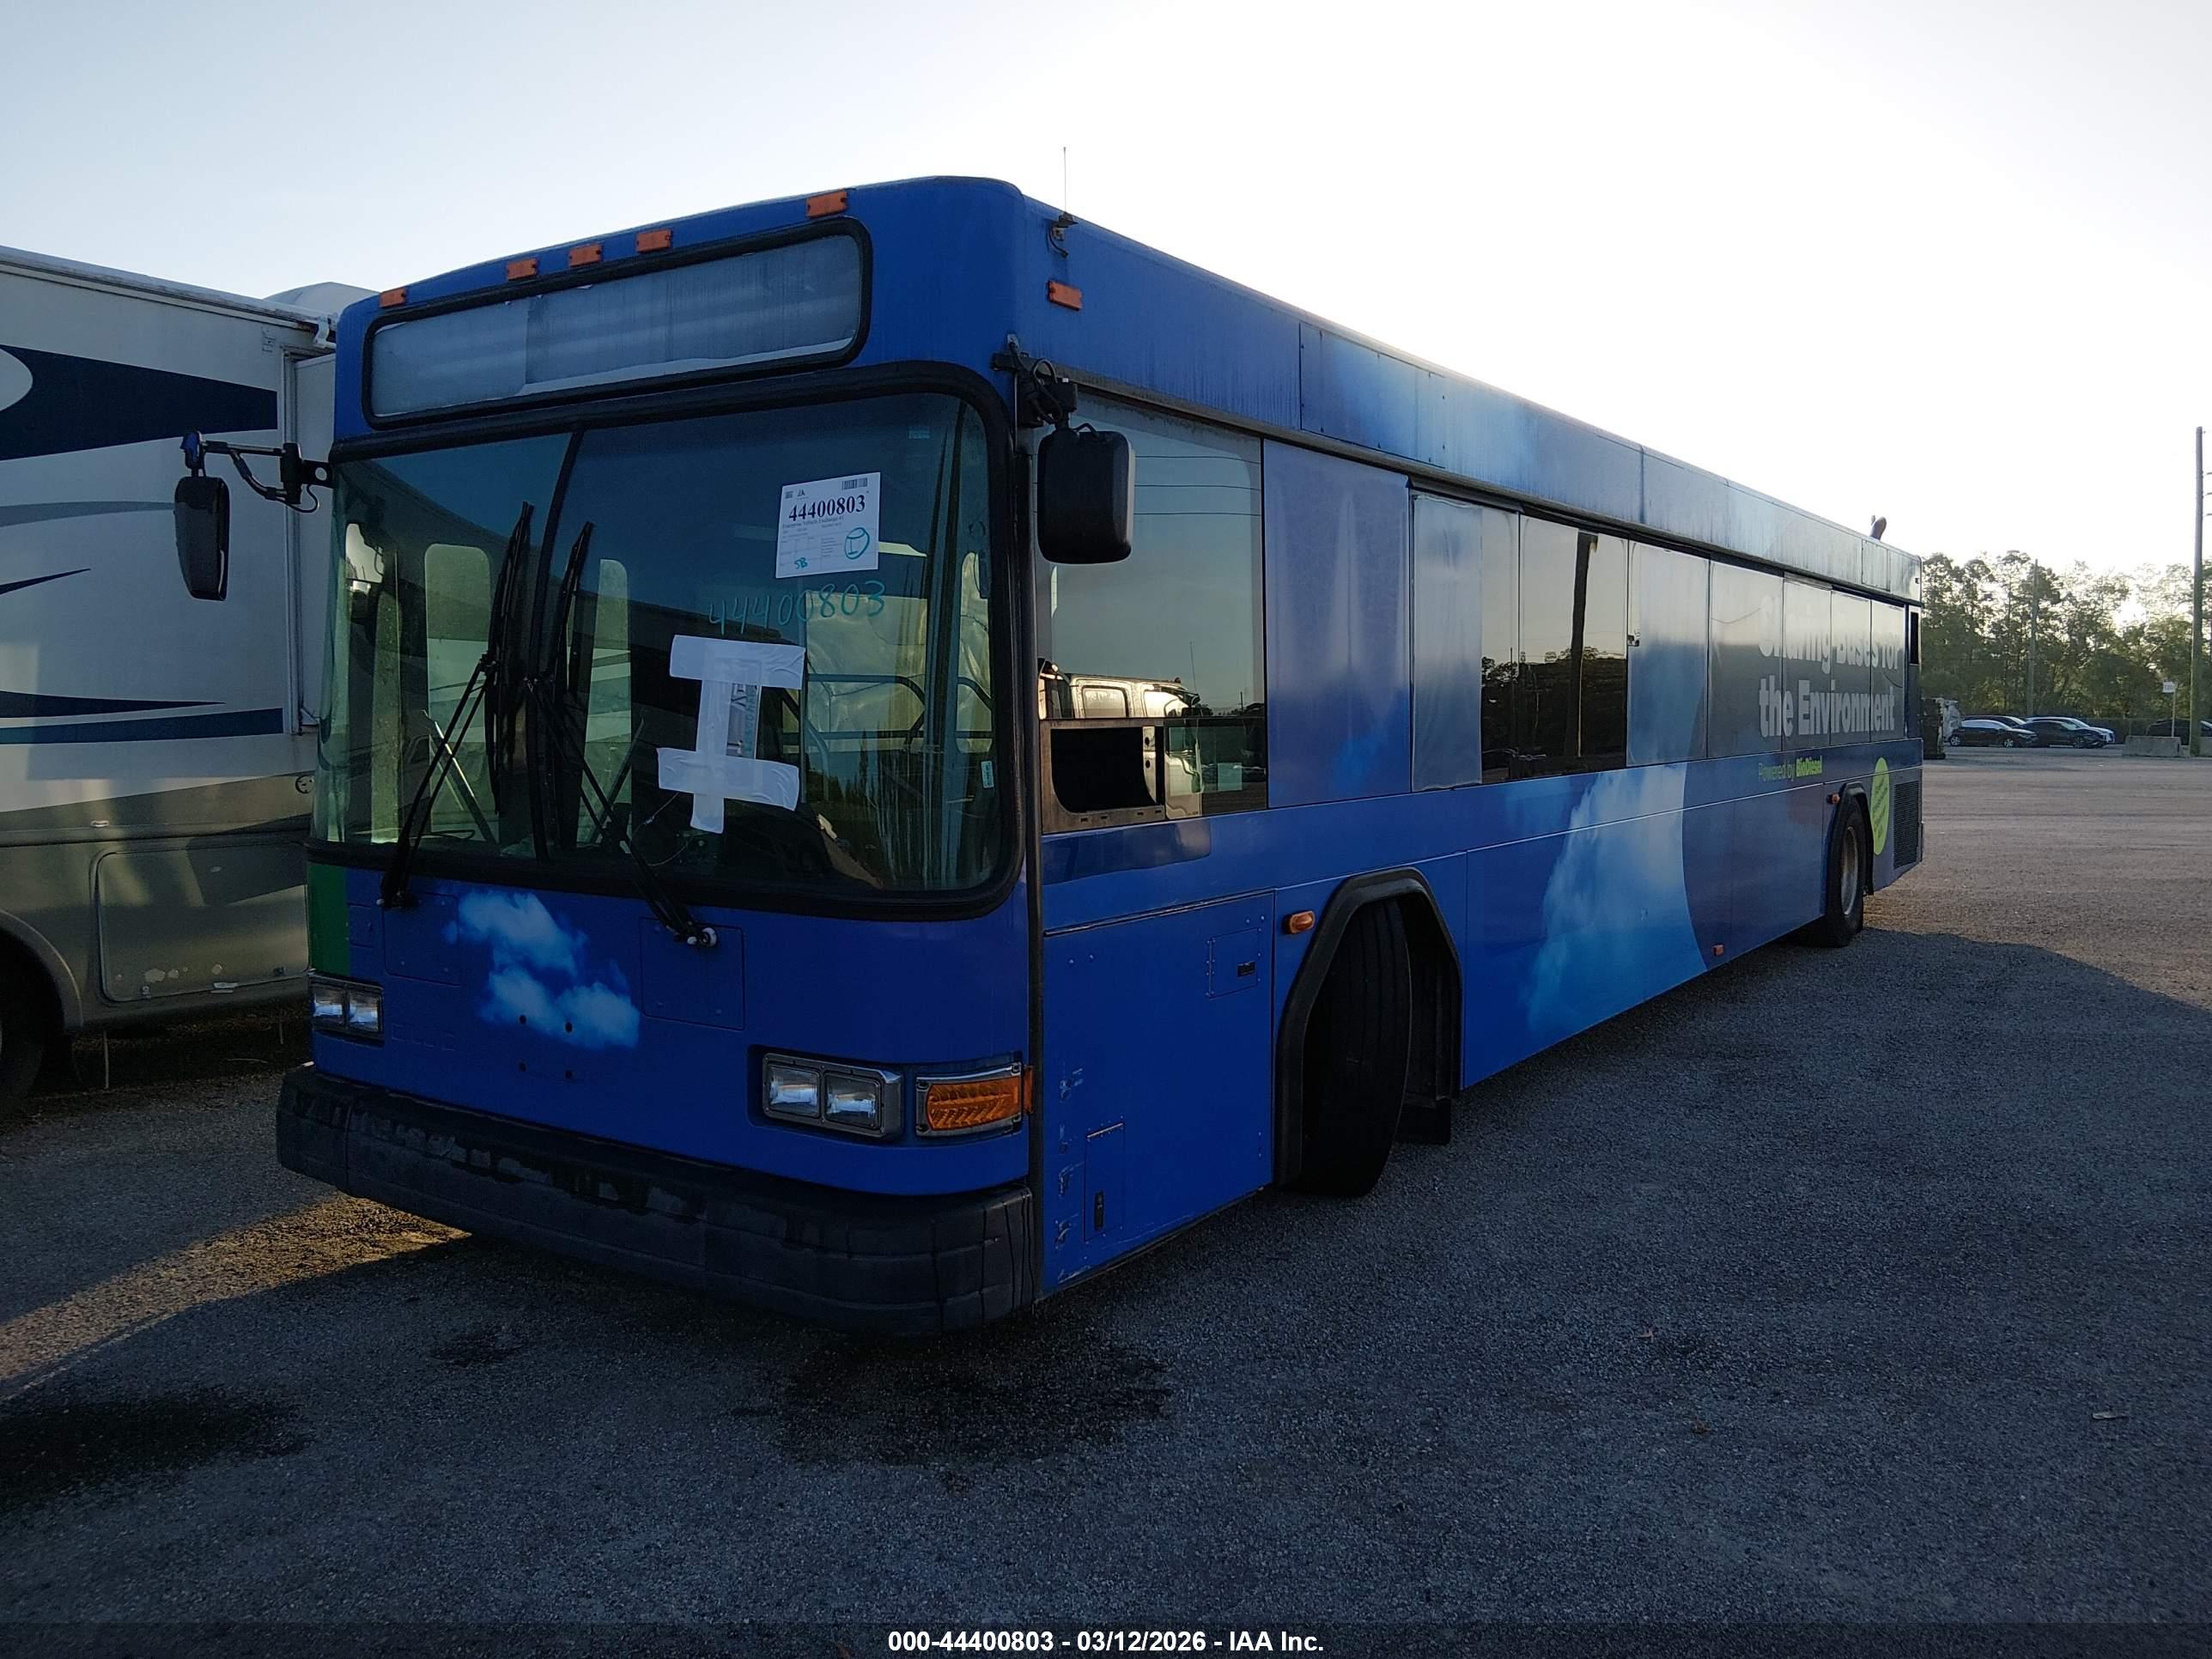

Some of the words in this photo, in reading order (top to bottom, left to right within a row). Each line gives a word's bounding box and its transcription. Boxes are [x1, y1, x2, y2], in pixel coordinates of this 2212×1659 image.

[788, 494, 866, 521] 44400803
[708, 580, 886, 635] 44400803
[1836, 620, 1879, 668] Buses
[1881, 628, 1901, 670] for
[1759, 675, 1794, 738] the
[1798, 678, 1896, 736] Environment
[1758, 761, 1787, 782] Powered
[1787, 761, 1796, 782] by
[1796, 755, 1823, 778] BioDiesel
